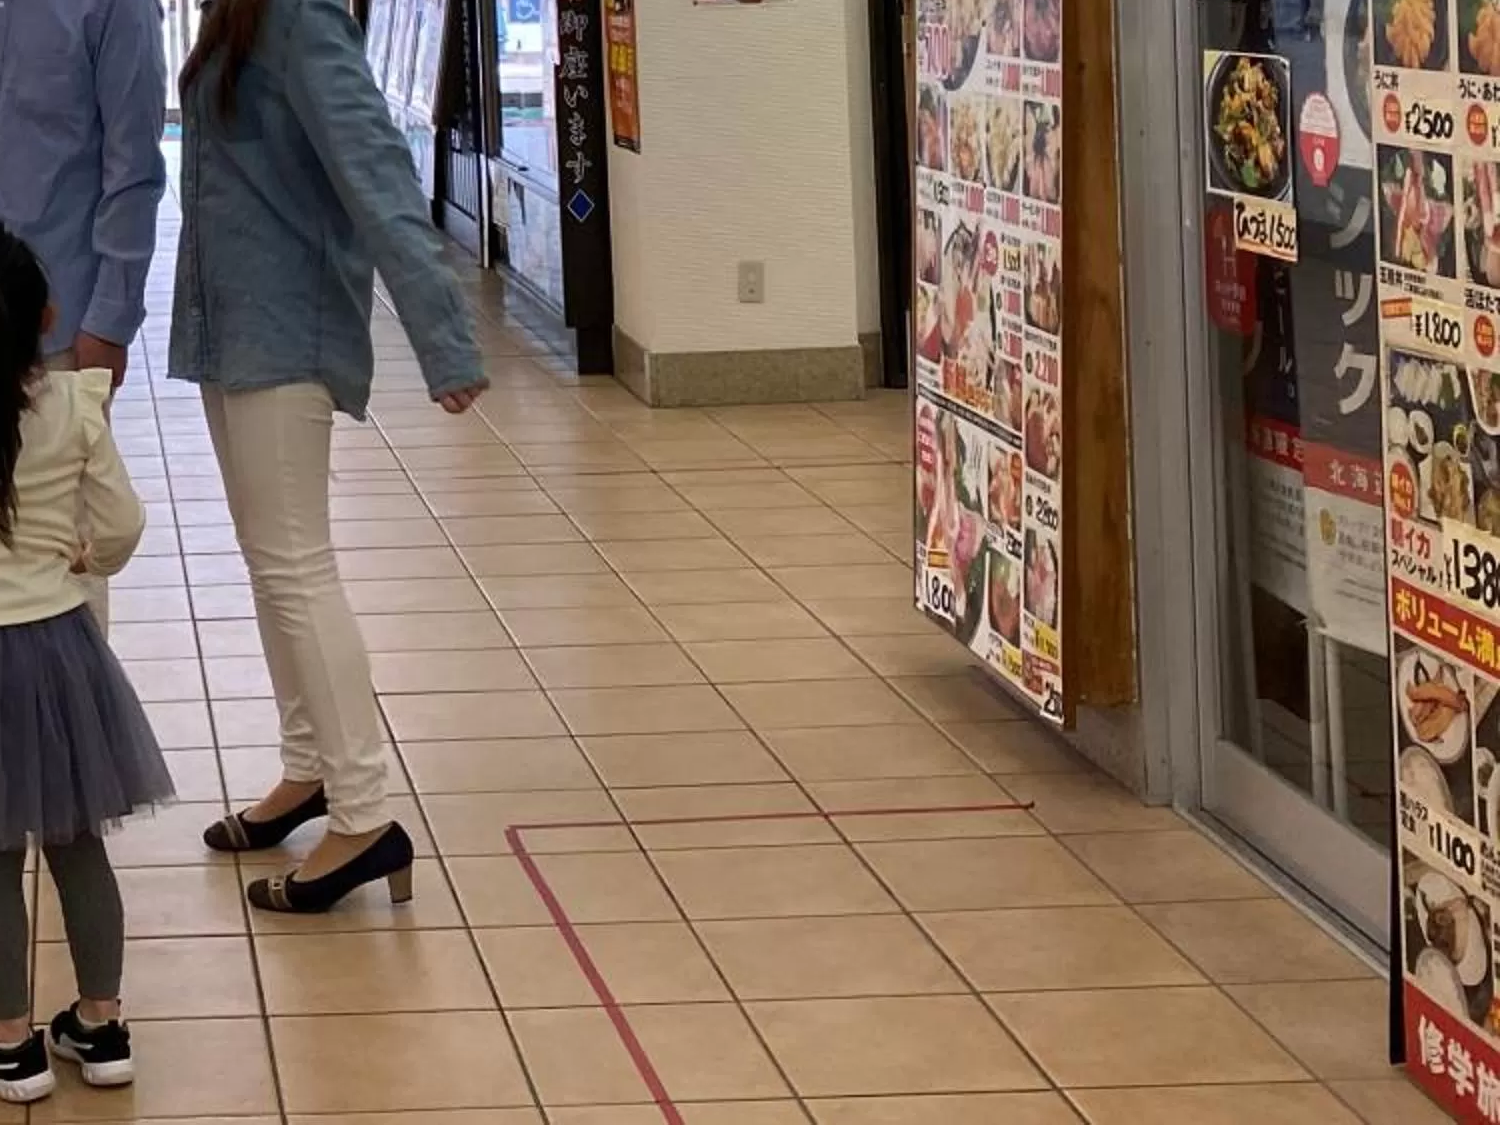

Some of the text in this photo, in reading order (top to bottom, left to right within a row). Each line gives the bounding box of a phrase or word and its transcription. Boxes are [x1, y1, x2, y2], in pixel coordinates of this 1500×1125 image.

[1395, 586, 1500, 671] ボリューム満
